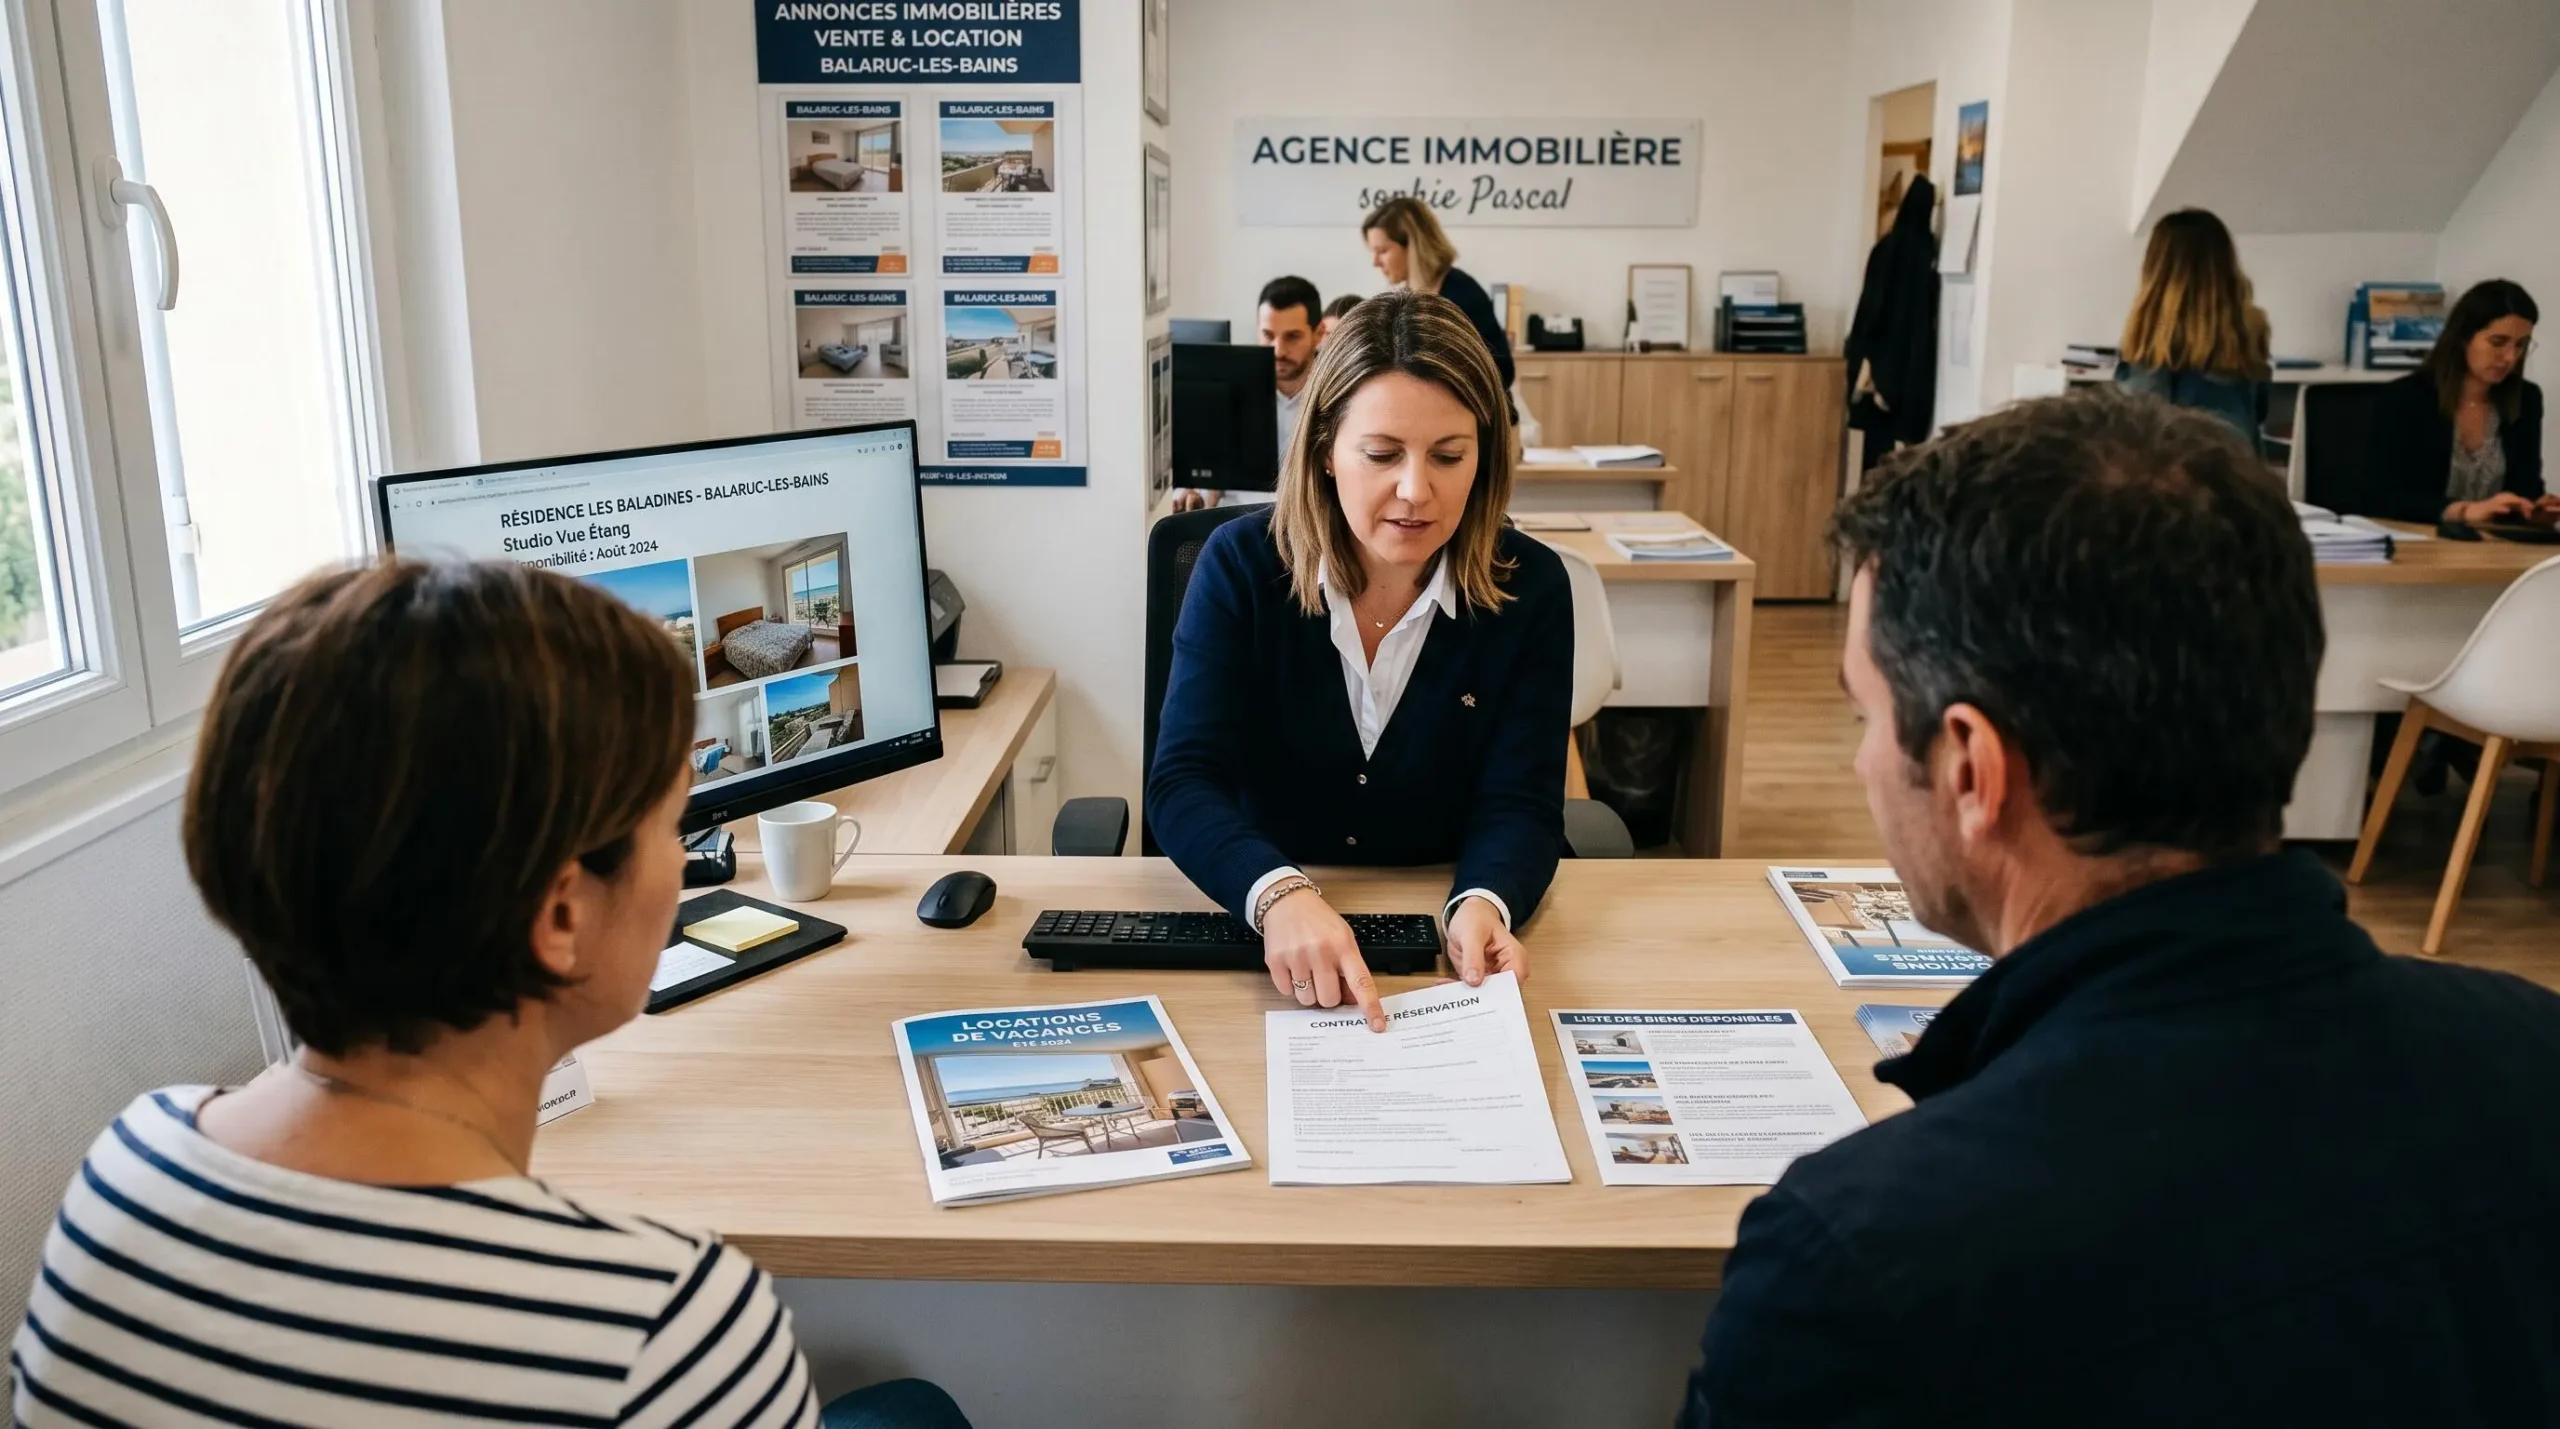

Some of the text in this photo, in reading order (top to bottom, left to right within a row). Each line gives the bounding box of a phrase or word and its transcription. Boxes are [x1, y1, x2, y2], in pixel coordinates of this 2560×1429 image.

[775, 0, 1061, 20] ANNONCES IMMOBILIÈRES
[814, 29, 1022, 47] VENTE & LOCATION
[821, 58, 1018, 73] BALARUC-LES-BAINS
[1252, 131, 1681, 165] AGENCE IMMOBILIÈRE
[1468, 174, 1573, 215] Pascal
[500, 504, 585, 529] RÉSIDENCE
[588, 500, 614, 516] LES
[617, 490, 693, 513] BALADINES
[704, 472, 829, 501] BALARUC-LES-BAINS
[503, 522, 631, 552] Studio Vue Étang
[597, 544, 626, 561] Août
[629, 540, 659, 555] 2024
[1393, 996, 1480, 1020] RÉSERVATION
[962, 1012, 1102, 1030] LOCATIONS
[1574, 1015, 1783, 1023] LISTE DES BIENS DISPONIBLES
[952, 1022, 1122, 1043] DE VACANCES
